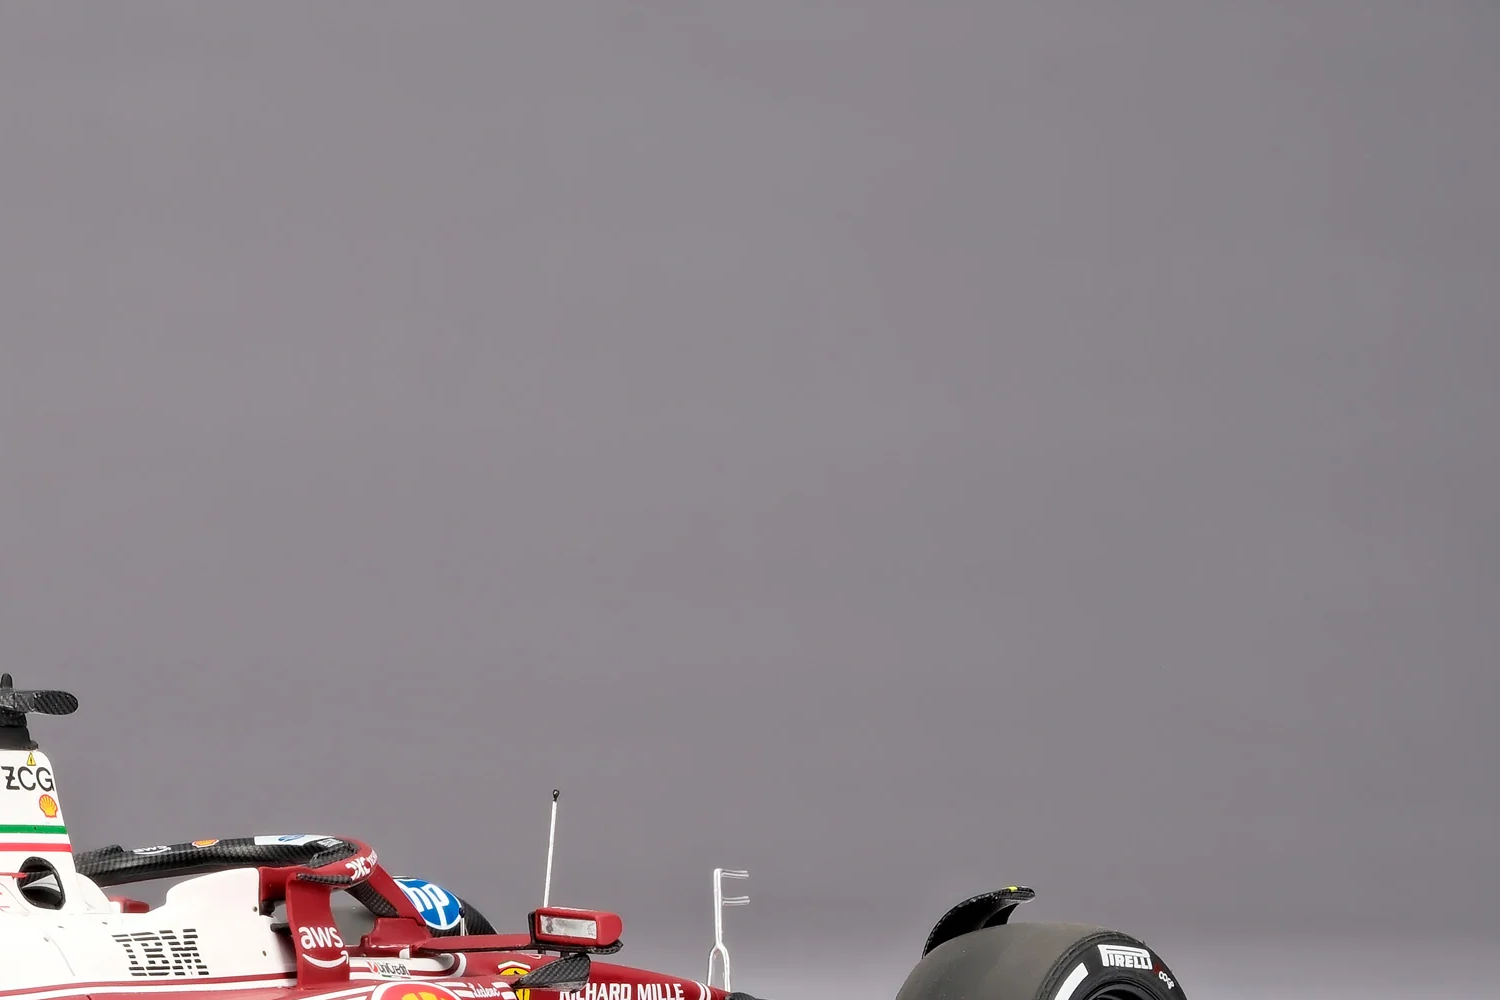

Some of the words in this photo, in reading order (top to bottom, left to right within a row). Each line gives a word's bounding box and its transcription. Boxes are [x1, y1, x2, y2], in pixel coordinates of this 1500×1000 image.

[299, 926, 344, 950] aws
[111, 928, 209, 976] IBM
[1097, 944, 1153, 970] PIRELLI
